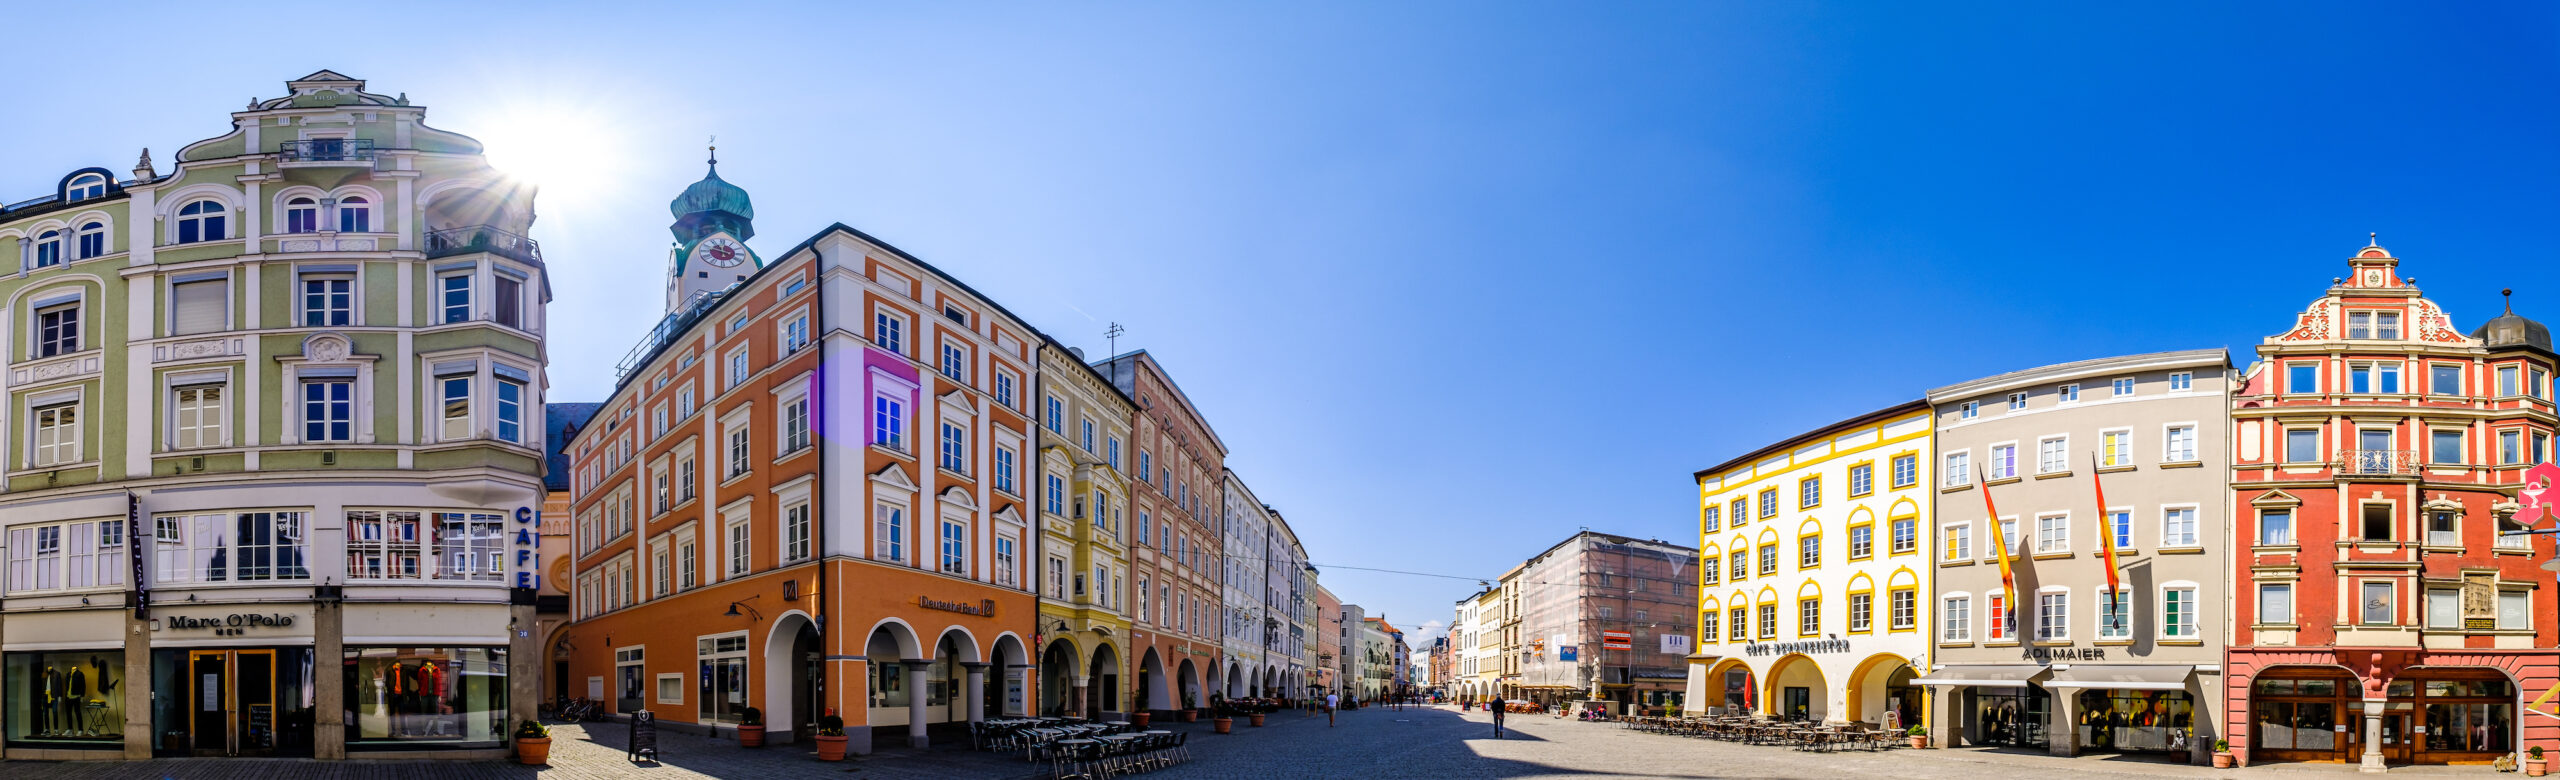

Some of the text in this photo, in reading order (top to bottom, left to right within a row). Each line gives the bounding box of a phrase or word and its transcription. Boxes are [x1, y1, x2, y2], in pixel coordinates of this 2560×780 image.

[516, 507, 531, 588] CAFE
[919, 595, 981, 616] Deutsche Bank
[168, 613, 293, 629] Marc O'Polo
[215, 628, 244, 636] MEN
[1745, 642, 1770, 657] CAFE
[2022, 648, 2105, 661] ADLMAIER
